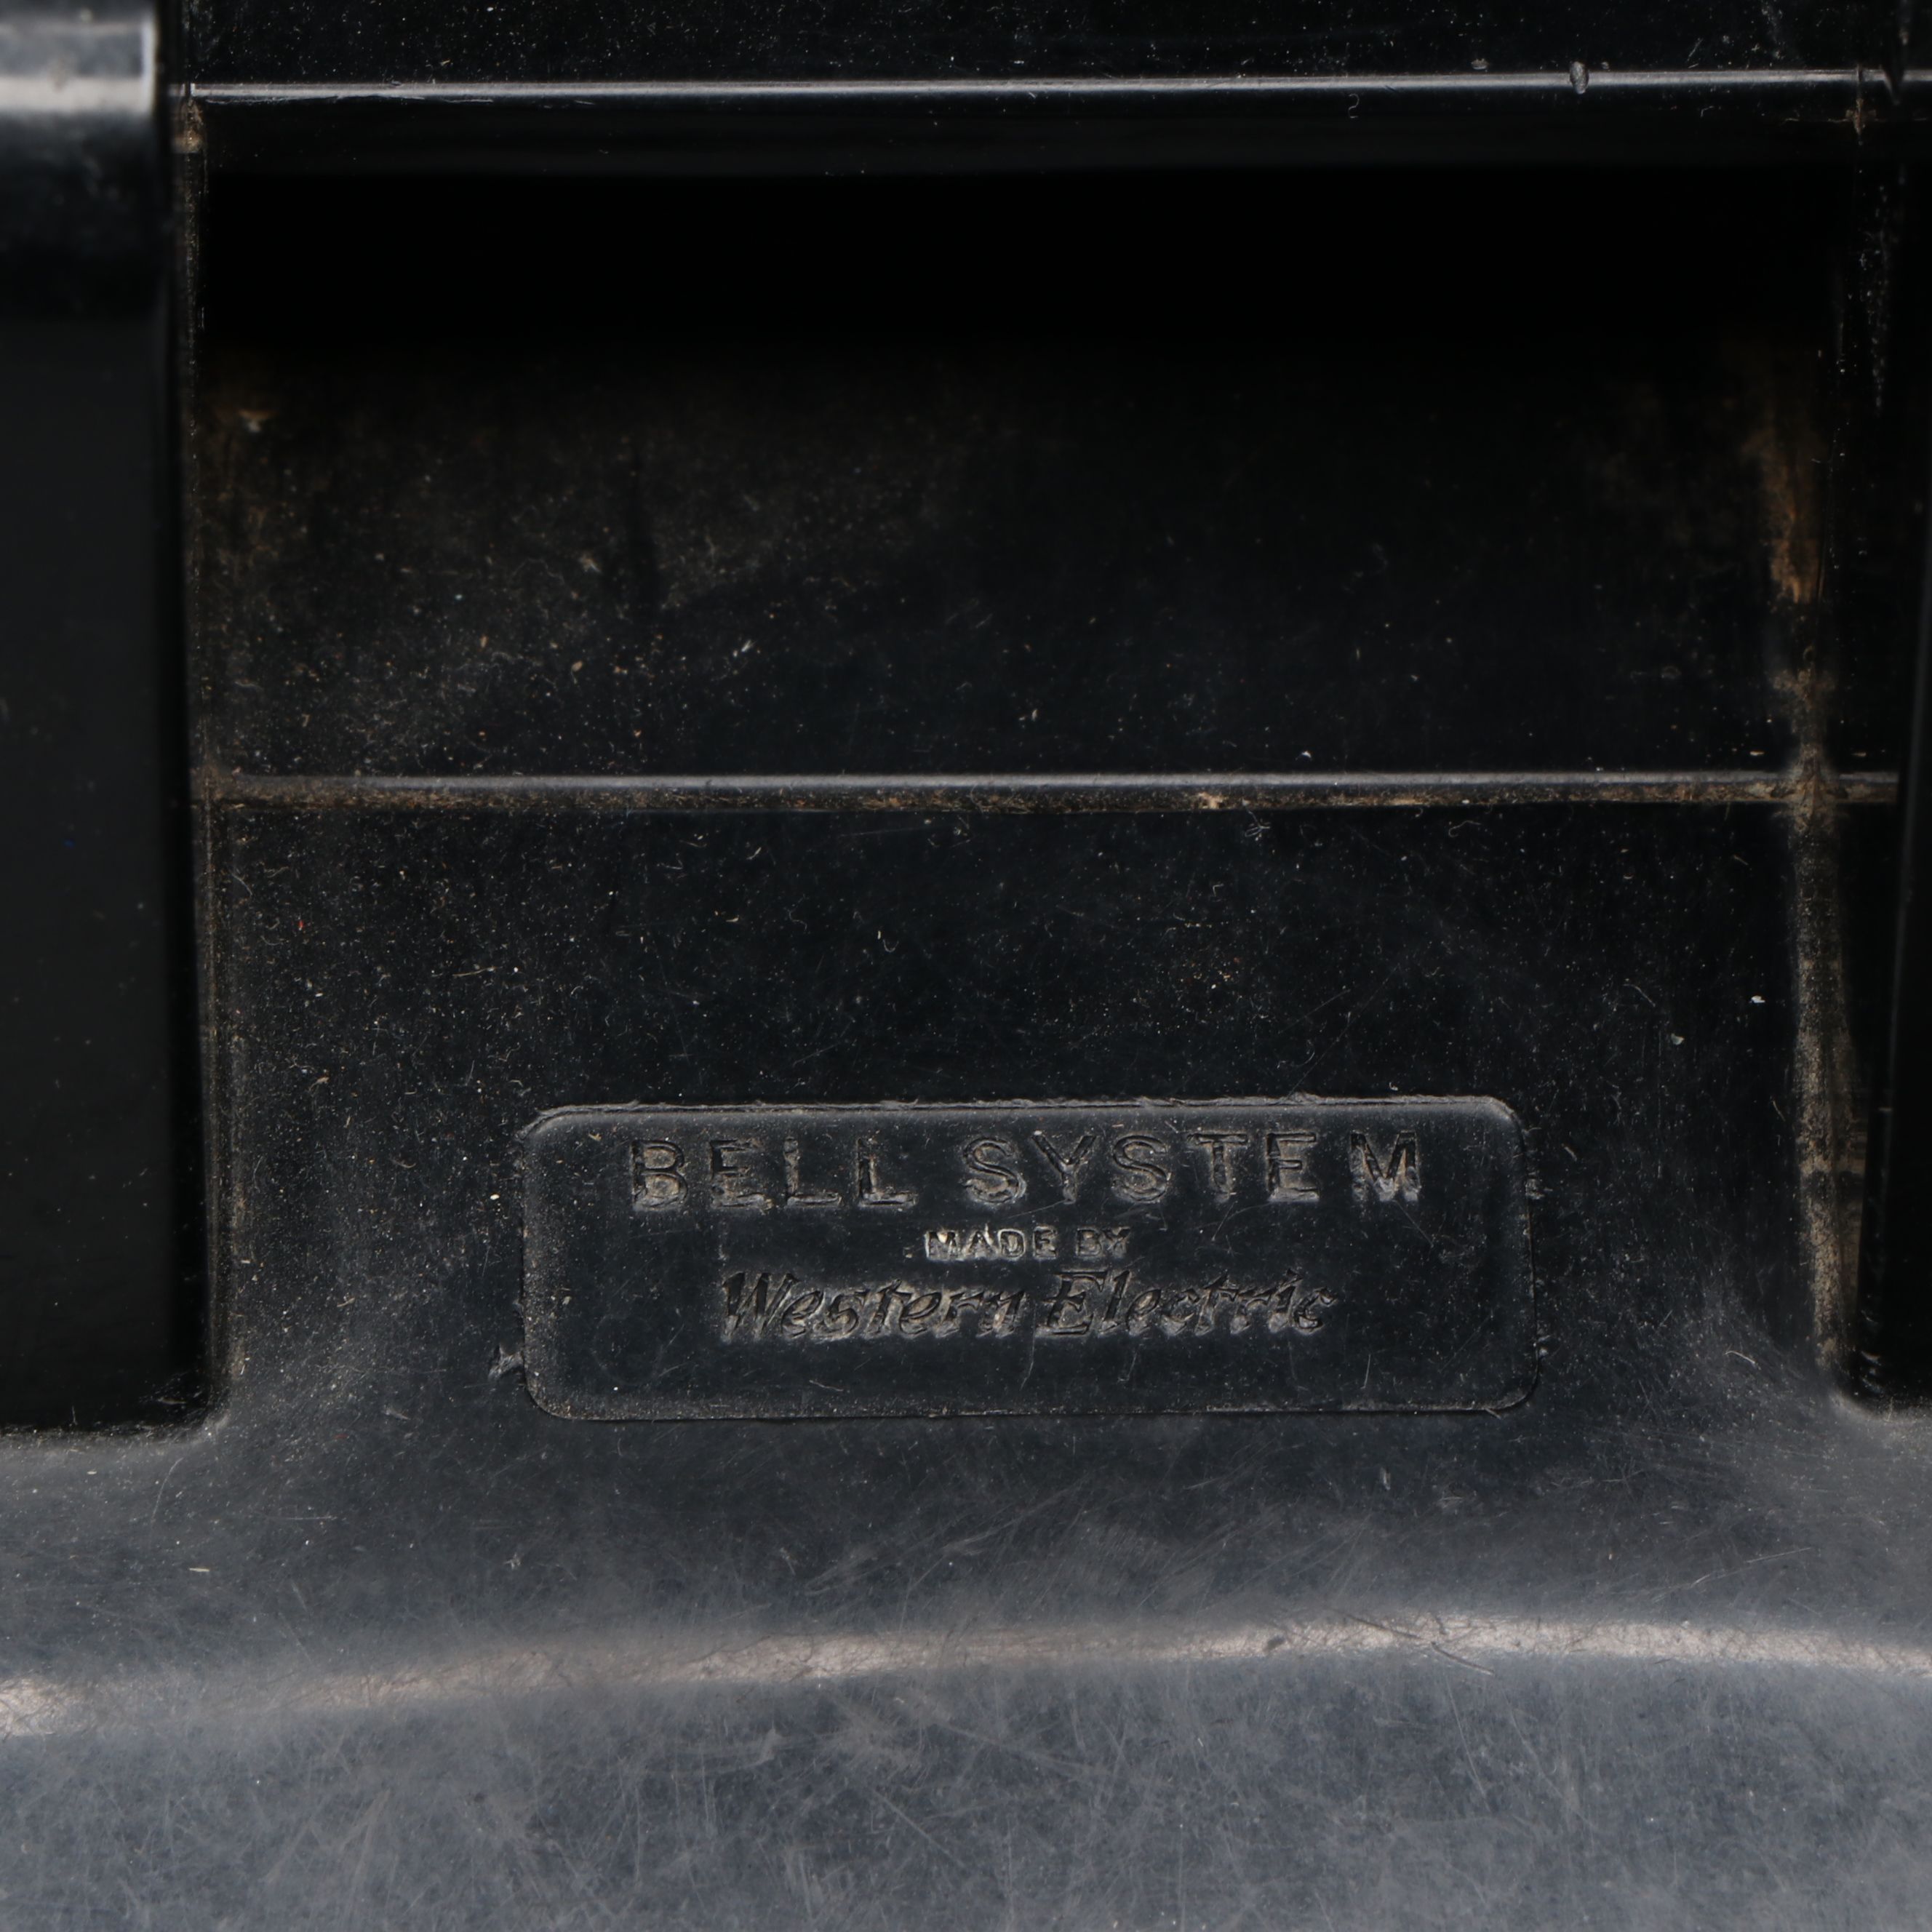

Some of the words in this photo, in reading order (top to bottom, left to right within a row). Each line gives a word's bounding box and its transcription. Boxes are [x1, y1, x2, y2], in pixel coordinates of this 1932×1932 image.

[630, 1138, 914, 1213] BELL
[962, 1129, 1423, 1206] SYSTEM
[924, 1227, 1058, 1260] MADE
[1077, 1226, 1132, 1258] BY
[722, 1270, 1026, 1343] Western
[1036, 1266, 1338, 1338] Electric
